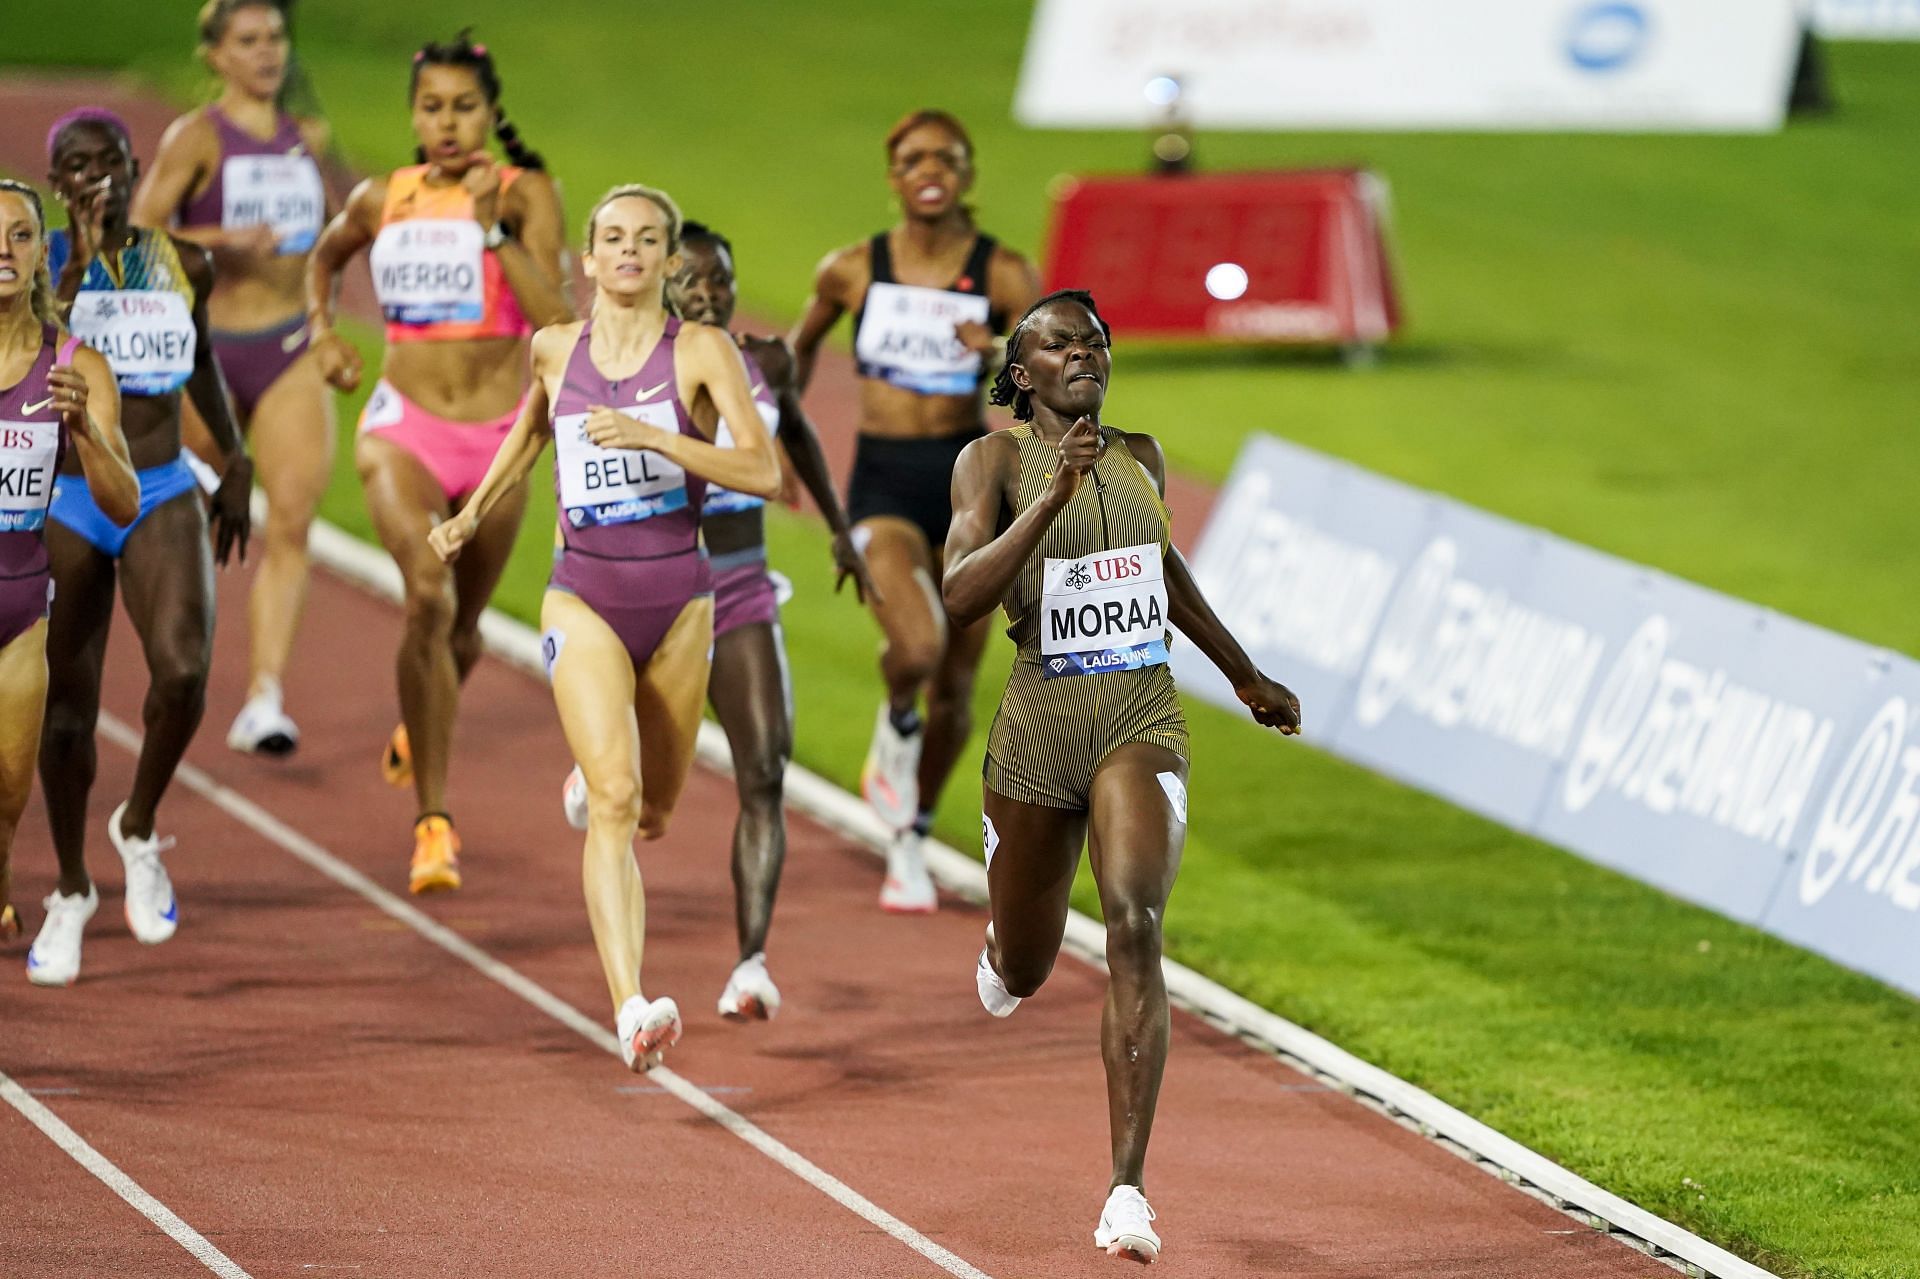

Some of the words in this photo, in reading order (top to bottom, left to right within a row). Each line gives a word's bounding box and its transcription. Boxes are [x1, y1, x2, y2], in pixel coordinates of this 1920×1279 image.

[381, 263, 475, 293] WERRO
[585, 454, 660, 490] BELL
[1093, 554, 1142, 582] UBS
[1050, 594, 1162, 641] MORAA
[1083, 648, 1152, 669] LAUSANNE
